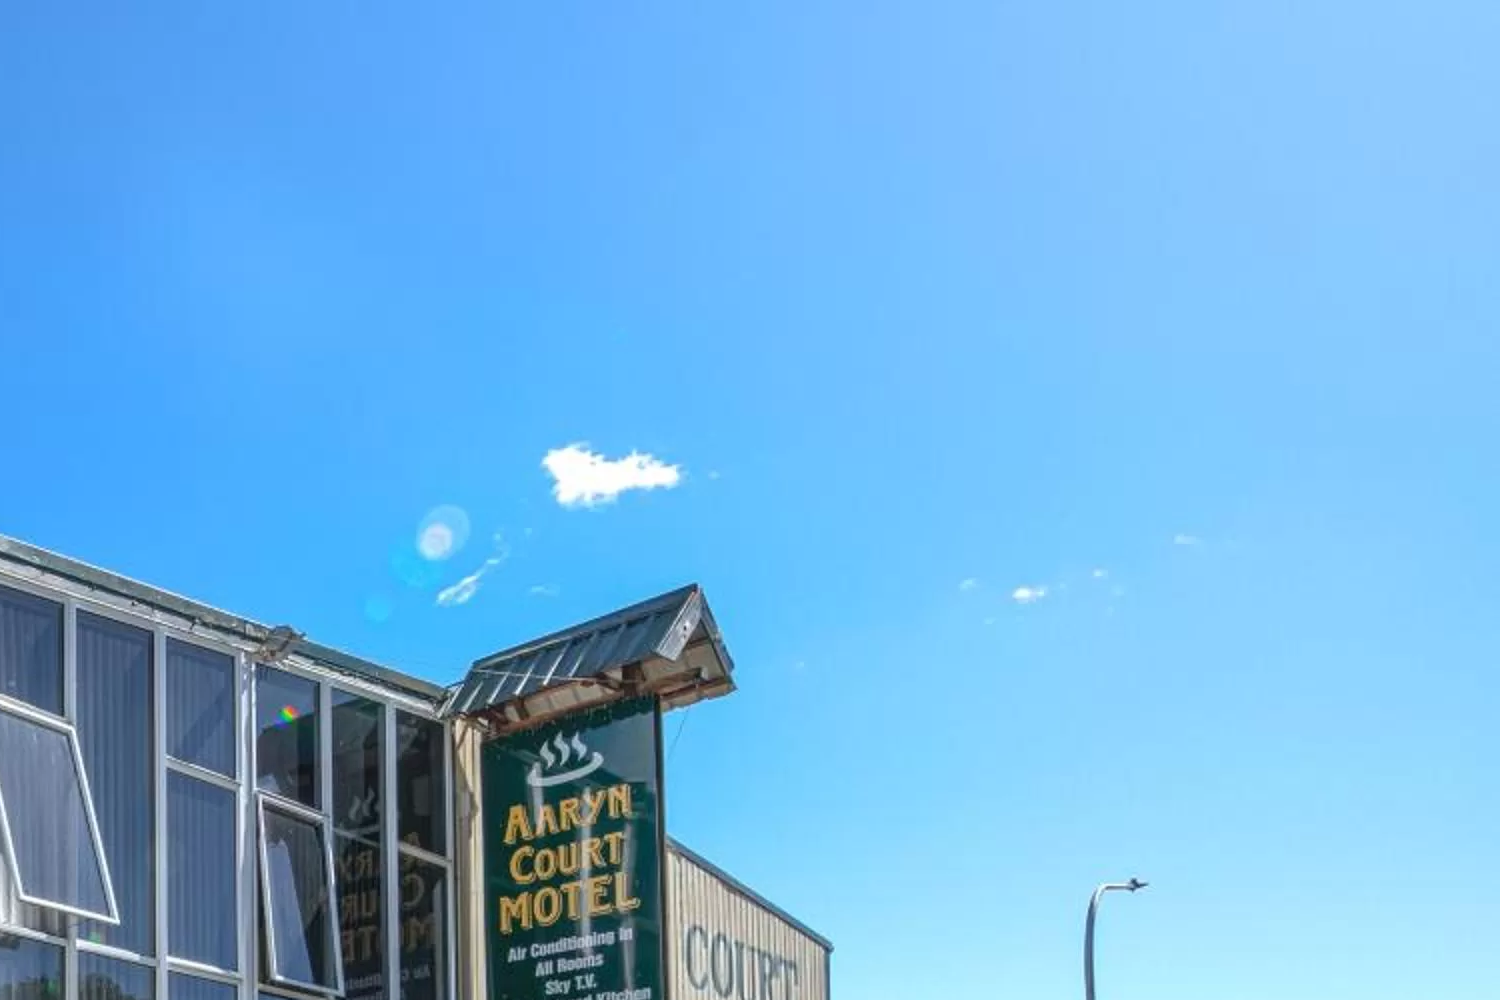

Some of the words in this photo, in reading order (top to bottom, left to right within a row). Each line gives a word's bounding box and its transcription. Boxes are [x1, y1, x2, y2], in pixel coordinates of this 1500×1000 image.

[503, 783, 632, 844] AARYN
[510, 831, 625, 884] COURT
[499, 871, 641, 935] MOTEL
[508, 946, 528, 963] Air
[530, 931, 615, 957] Conditioning
[535, 961, 554, 977] All
[557, 954, 605, 973] Rooms
[545, 979, 571, 995] Sky
